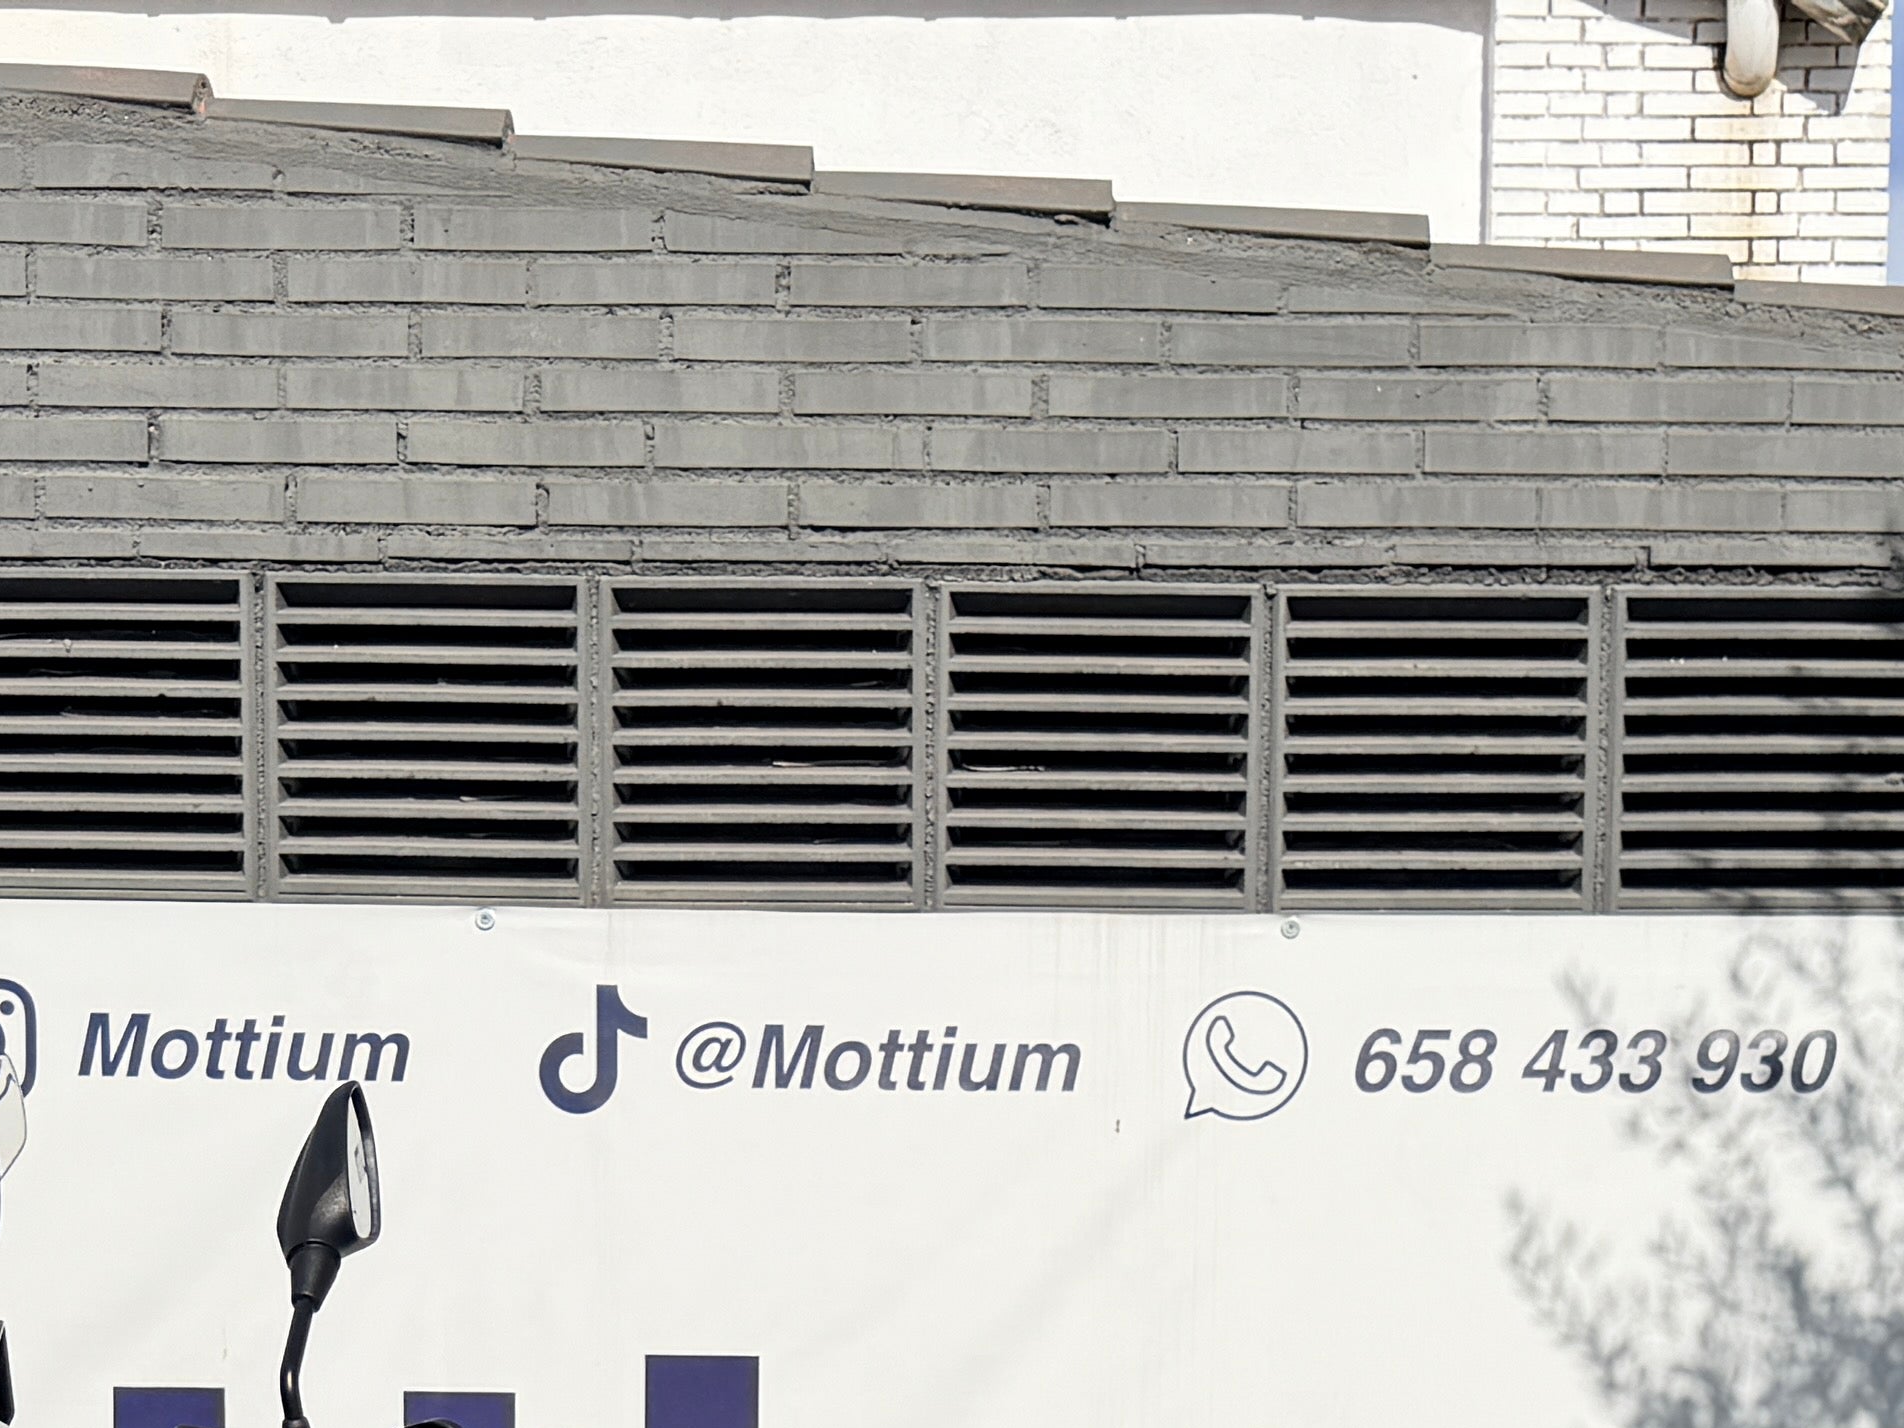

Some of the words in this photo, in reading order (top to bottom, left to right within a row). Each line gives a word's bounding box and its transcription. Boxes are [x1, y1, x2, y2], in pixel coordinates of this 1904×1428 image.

[78, 1012, 410, 1082] Mottium
[675, 1021, 1081, 1092] @Mottium
[1354, 1028, 1498, 1093] 658
[1521, 1029, 1667, 1093] 433
[1692, 1029, 1837, 1093] 930
